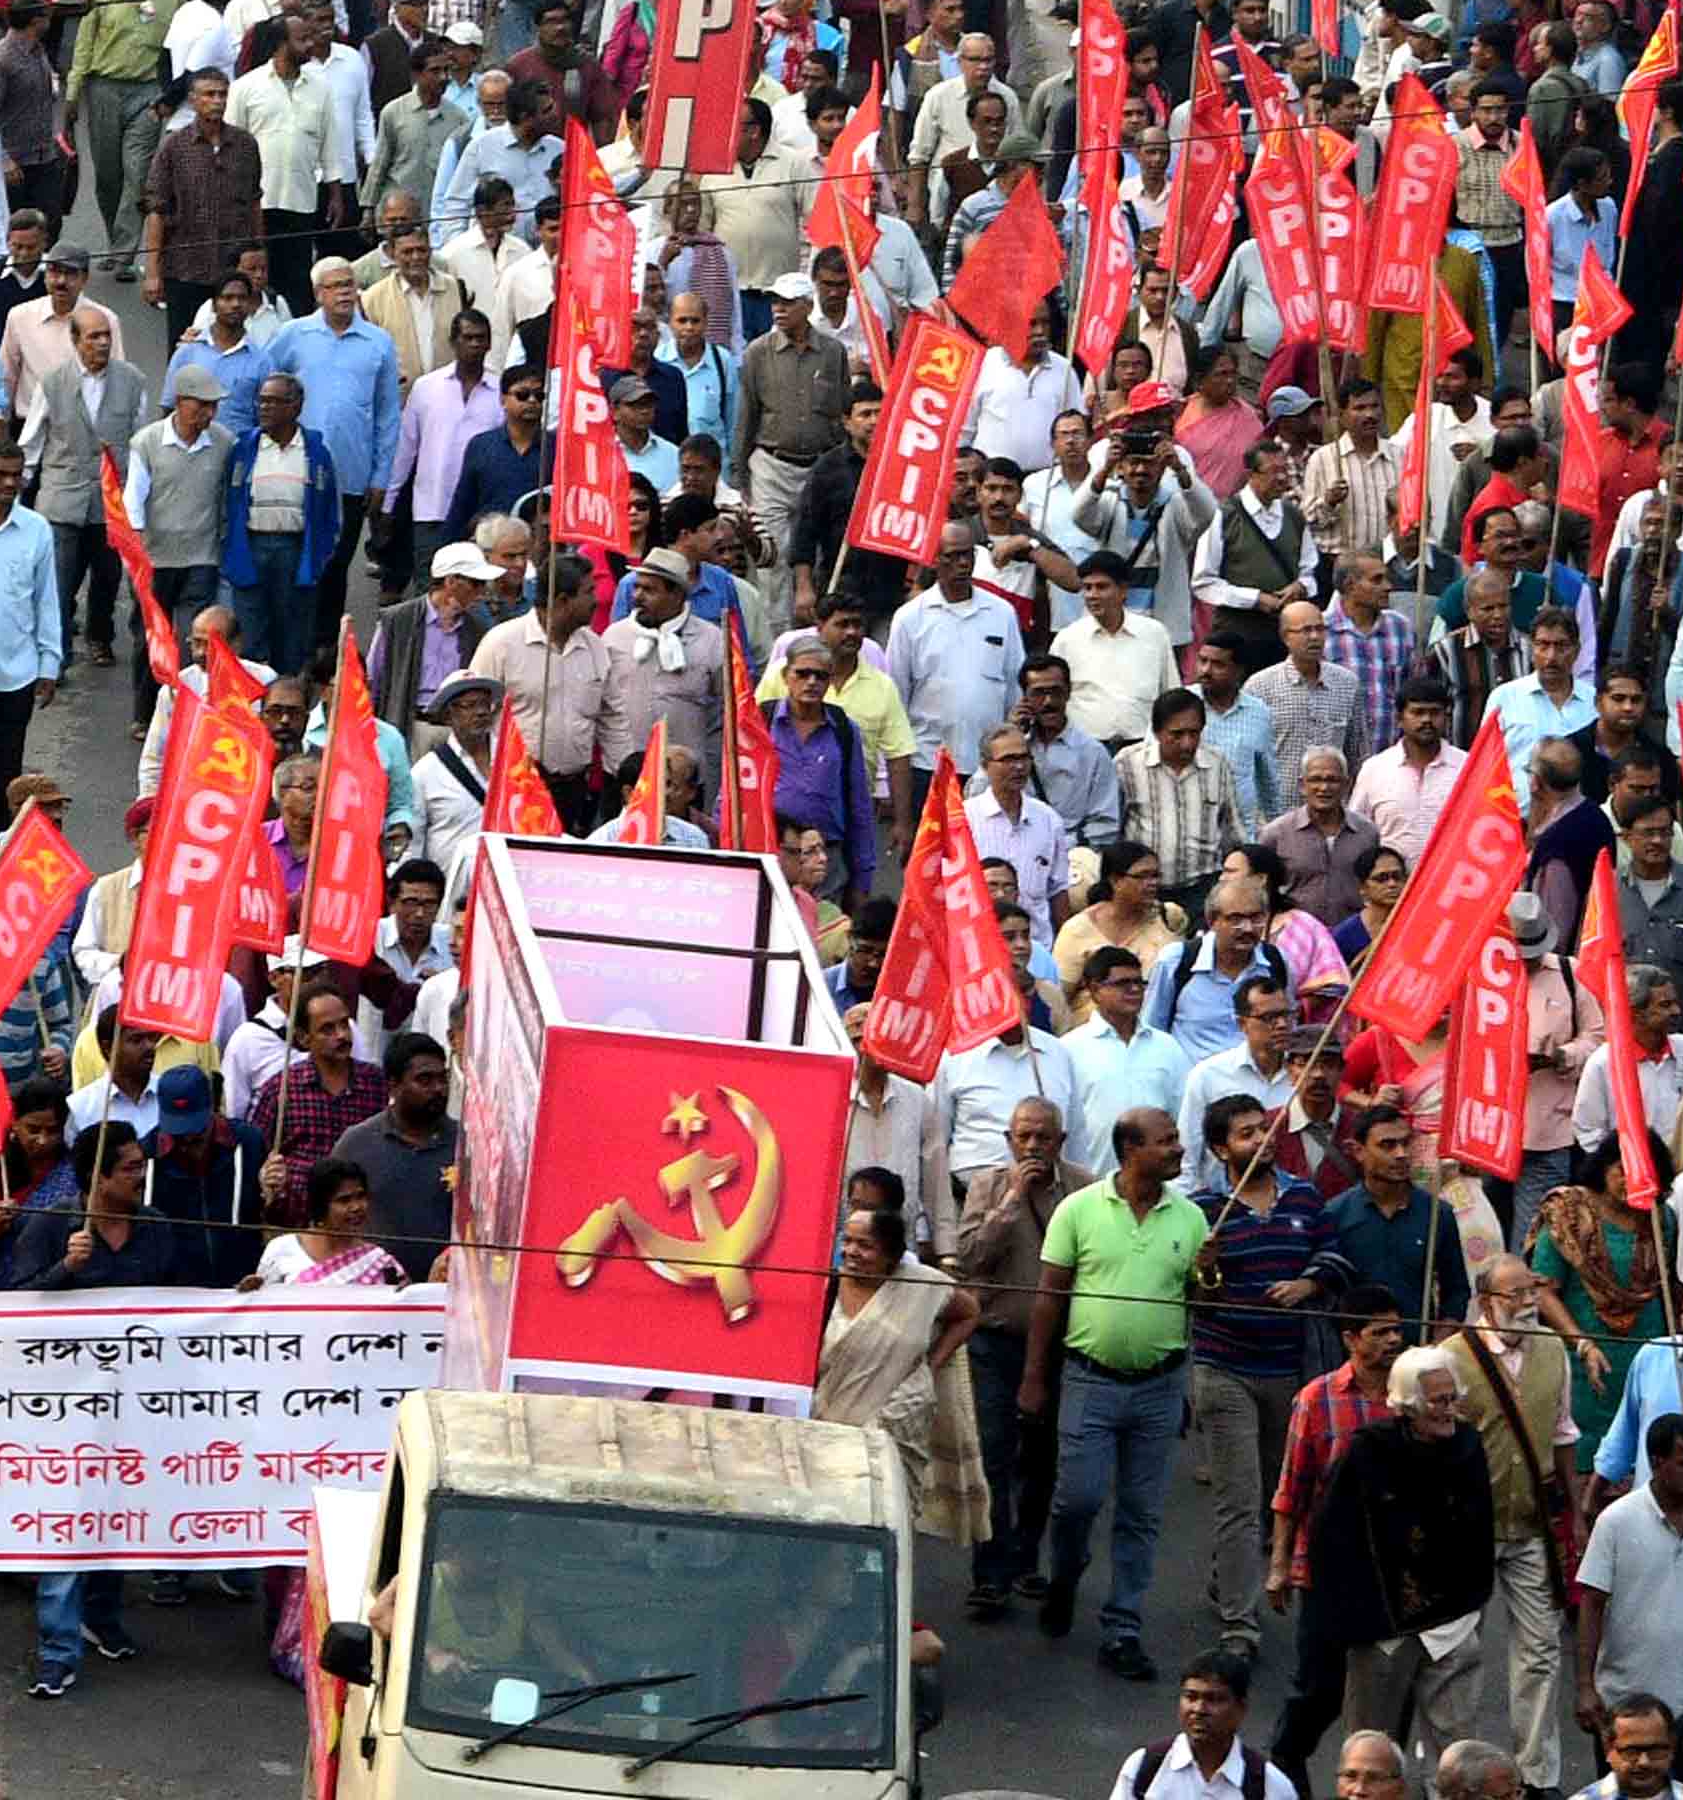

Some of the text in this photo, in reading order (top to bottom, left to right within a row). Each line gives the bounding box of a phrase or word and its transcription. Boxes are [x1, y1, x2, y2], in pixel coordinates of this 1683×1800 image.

[19, 1325, 165, 1375] রঙ্গভূমি
[179, 1330, 303, 1364] আমার
[324, 1330, 409, 1364] দেশ
[136, 1384, 260, 1420] আমার
[281, 1384, 363, 1419] দেশ
[160, 1440, 247, 1486] পার্টি
[10, 1505, 150, 1544] পরগণা
[167, 1503, 268, 1543] জেলা
